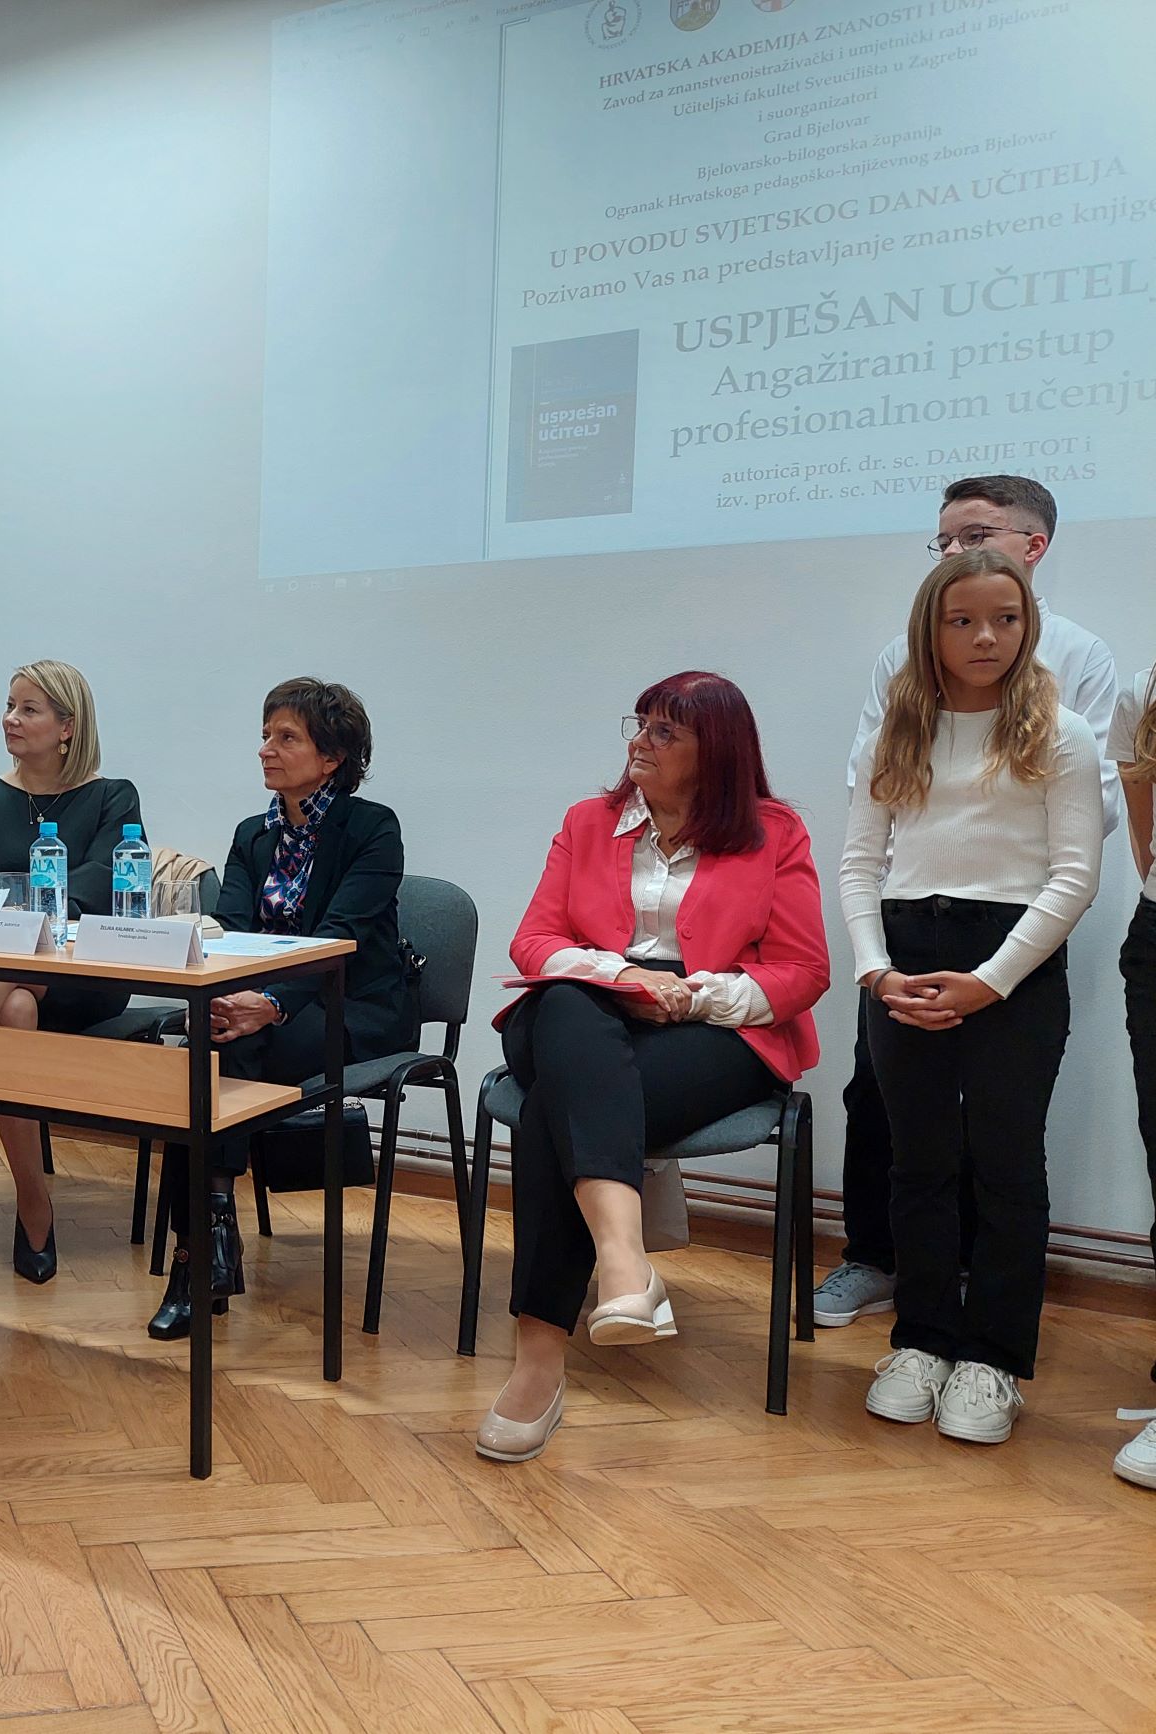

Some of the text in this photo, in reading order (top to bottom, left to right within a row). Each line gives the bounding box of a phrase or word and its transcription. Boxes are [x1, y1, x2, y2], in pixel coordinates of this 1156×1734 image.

[598, 57, 692, 89] HRVATSKA
[697, 29, 809, 67] AKADEMIJA
[814, 5, 923, 42] ZNANOSTI
[602, 90, 645, 111] Zavod
[648, 88, 664, 102] za
[667, 48, 834, 97] znanstvenoistraživački
[838, 46, 844, 60] i
[848, 29, 934, 58] umjetnički
[939, 22, 966, 40] rad
[971, 21, 982, 33] u
[987, 2, 1070, 32] Bjelovaru
[673, 93, 739, 117] Učiteljski
[743, 80, 801, 104] fakultet
[894, 60, 903, 72] u
[908, 46, 978, 71] Zagrebu
[758, 88, 878, 123] i suorganizatori
[764, 114, 871, 144] Grad Bjelovar
[605, 129, 1057, 220] Ogranak Hrvatskoga pedagoško-književnog zbora Bjelovar
[697, 125, 942, 181] Bjelovarsko-bilogorska županija
[550, 155, 1128, 268] U POVODU SVJETSKOG DANA UČITELJA
[522, 279, 627, 308] Pozivamo
[633, 270, 674, 290] Vas
[682, 267, 710, 283] na
[717, 233, 895, 284] predstavljanje
[903, 212, 1063, 250] znanstvene
[673, 258, 1156, 354] USPJEŠAN UČITEL
[711, 327, 1114, 399] Angažirani pristup
[669, 370, 1156, 458] profesionalnom učenju
[716, 462, 1096, 509] izv. prof. dr. sc. NEVEN ARAS
[804, 456, 851, 482] prof.
[859, 454, 886, 471] dr.
[893, 456, 918, 469] sc.
[927, 442, 1016, 466] DARIJE
[1023, 437, 1078, 457] TOT
[1084, 436, 1091, 453] i
